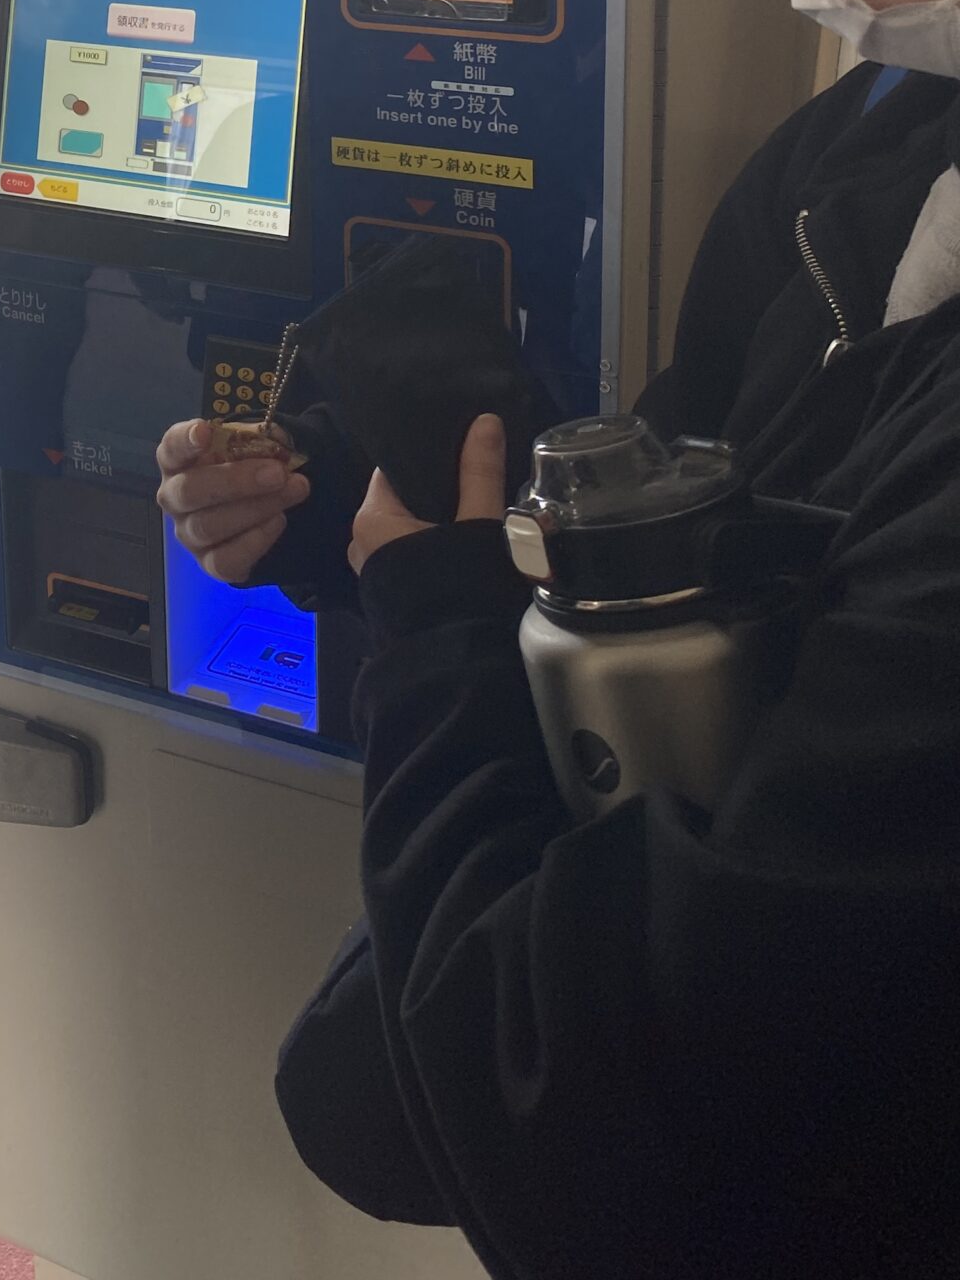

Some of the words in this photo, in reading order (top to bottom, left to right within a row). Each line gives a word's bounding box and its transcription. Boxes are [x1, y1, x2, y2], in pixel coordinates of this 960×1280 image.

[453, 41, 498, 64] 紙幣
[464, 65, 486, 81] Bill
[386, 88, 507, 117] 一枚ずつ投入
[376, 106, 424, 123] Insert
[427, 116, 457, 128] one
[461, 115, 482, 134] by
[335, 145, 528, 182] 硬貨は一枚ずつ斜めに投入
[453, 188, 497, 212] 硬貨
[455, 210, 495, 228] Coin
[0, 286, 47, 310] とりけし
[2, 305, 45, 324] Cancel
[72, 456, 113, 476] Ticket
